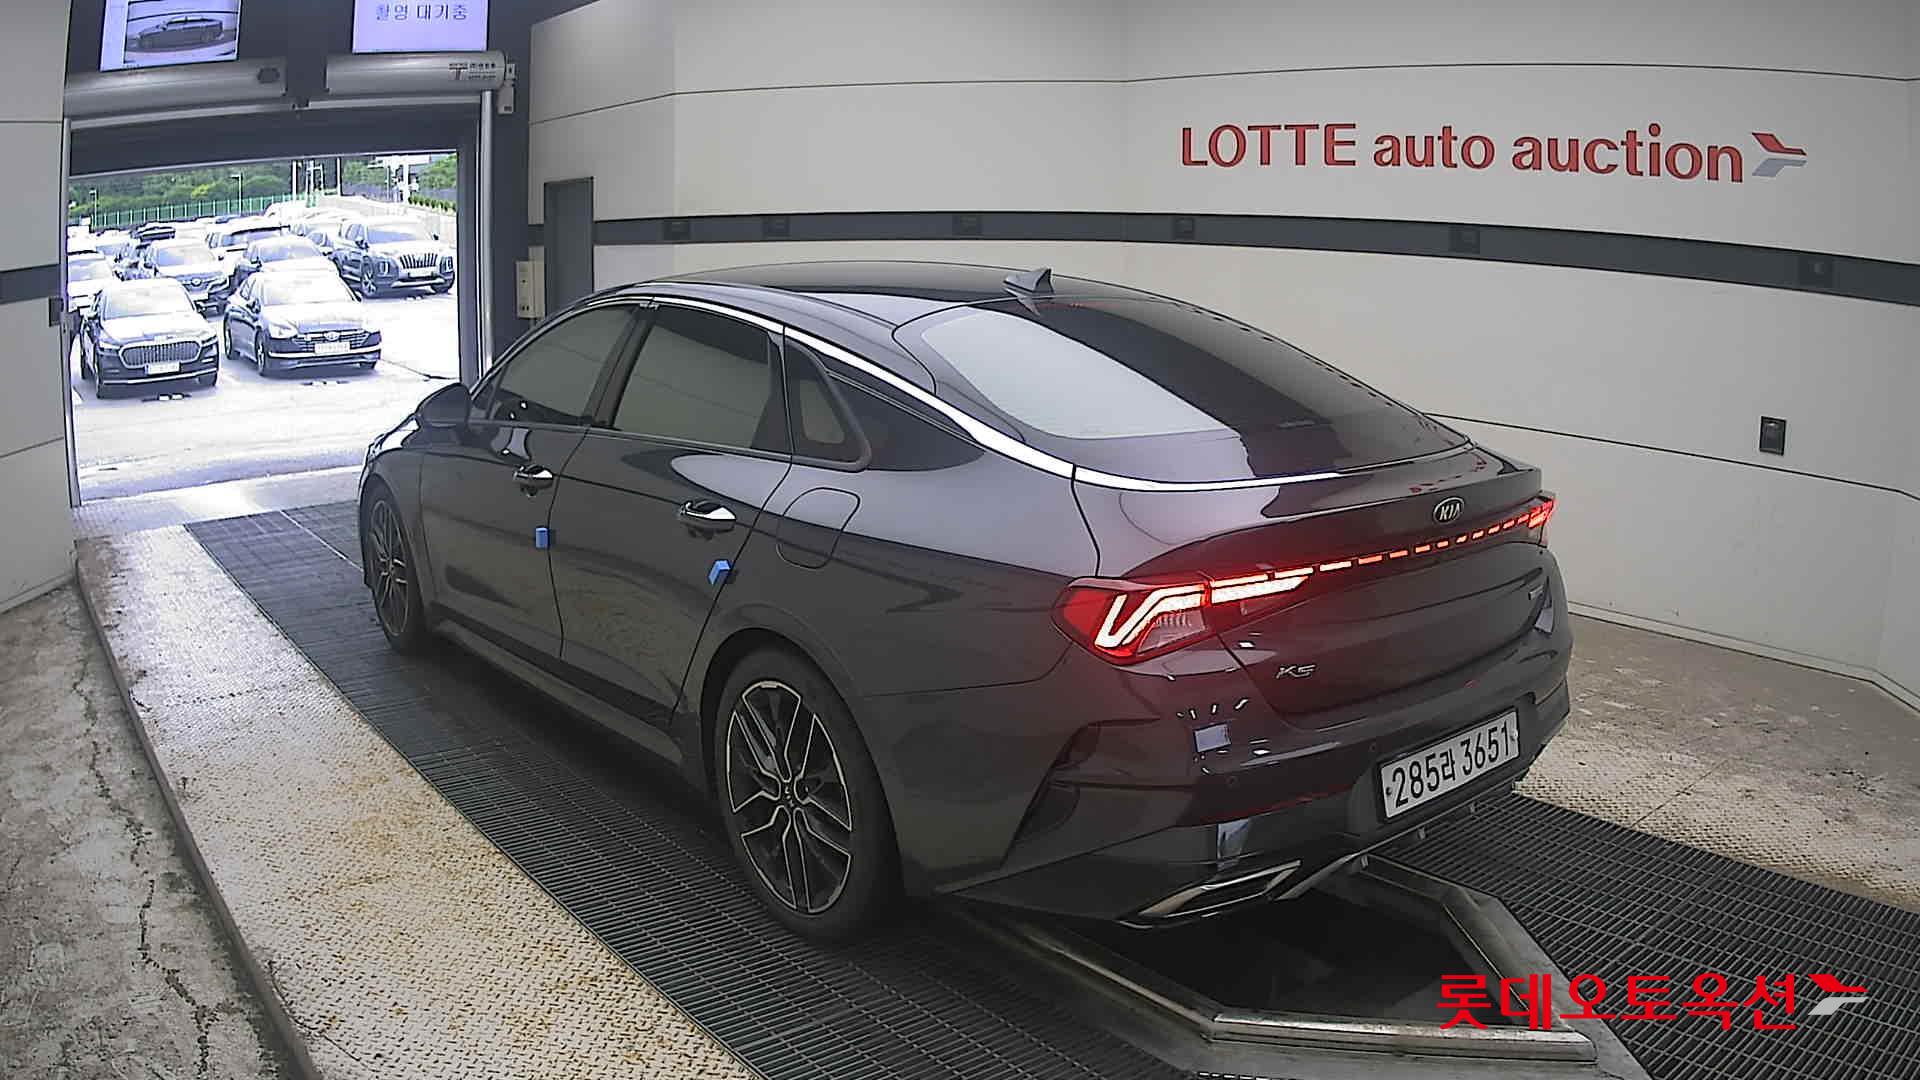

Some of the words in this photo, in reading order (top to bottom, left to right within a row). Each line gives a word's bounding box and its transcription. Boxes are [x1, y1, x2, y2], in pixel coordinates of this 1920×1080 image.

[1181, 123, 1356, 167] LOTTE
[1373, 124, 1495, 169] auto
[1512, 123, 1743, 183] auction
[1438, 502, 1461, 521] KIA
[1276, 664, 1316, 680] K5
[1392, 748, 1457, 808] 285라
[1459, 720, 1510, 776] 3651
